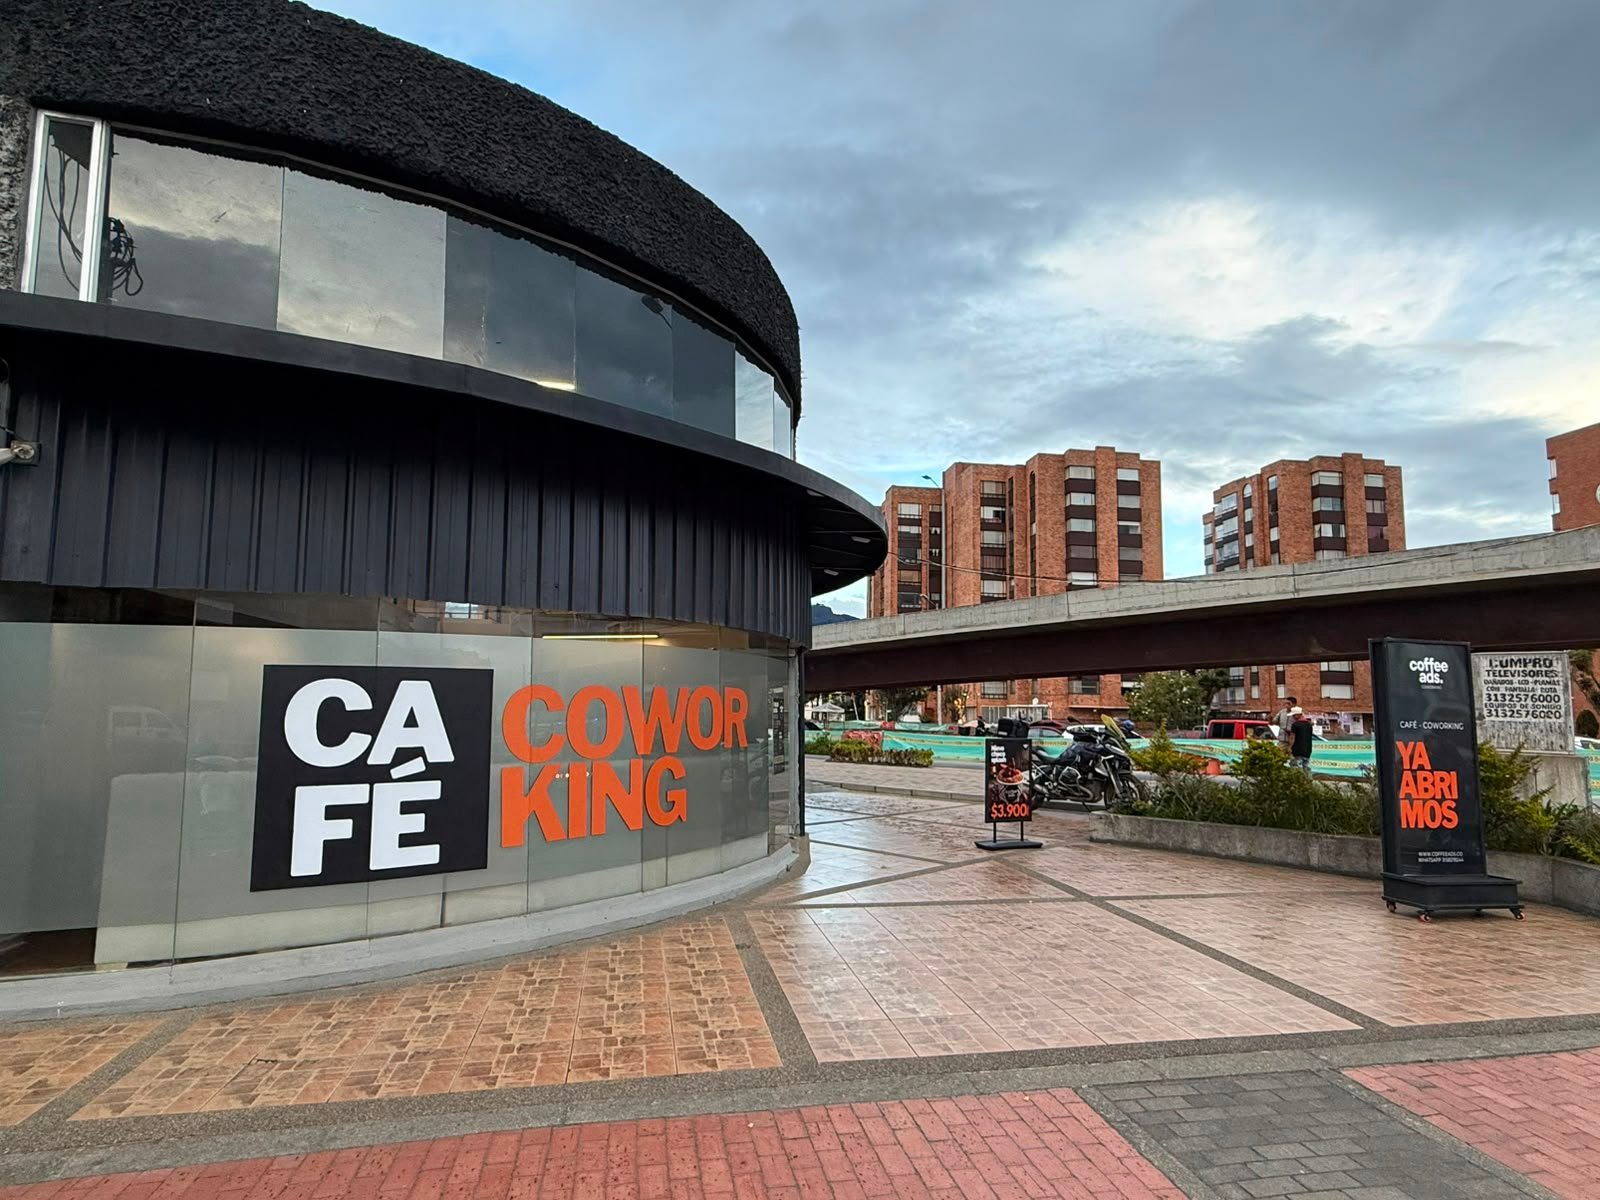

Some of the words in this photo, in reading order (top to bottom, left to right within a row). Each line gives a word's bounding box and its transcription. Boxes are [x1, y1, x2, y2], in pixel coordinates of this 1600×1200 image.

[1409, 657, 1449, 673] coffee
[1419, 672, 1444, 684] ads.
[1485, 669, 1560, 678] TELEVISORES
[1485, 693, 1561, 703] 3132576000
[284, 678, 454, 767] CA
[502, 684, 749, 763] COWOR
[1400, 720, 1418, 729] CAFÉ
[1422, 721, 1464, 730] COWORKING
[1396, 741, 1431, 770] YA
[1399, 770, 1458, 799] ABRI
[291, 756, 441, 877] FÉ
[500, 756, 687, 848] KING
[1400, 799, 1459, 829] MOS
